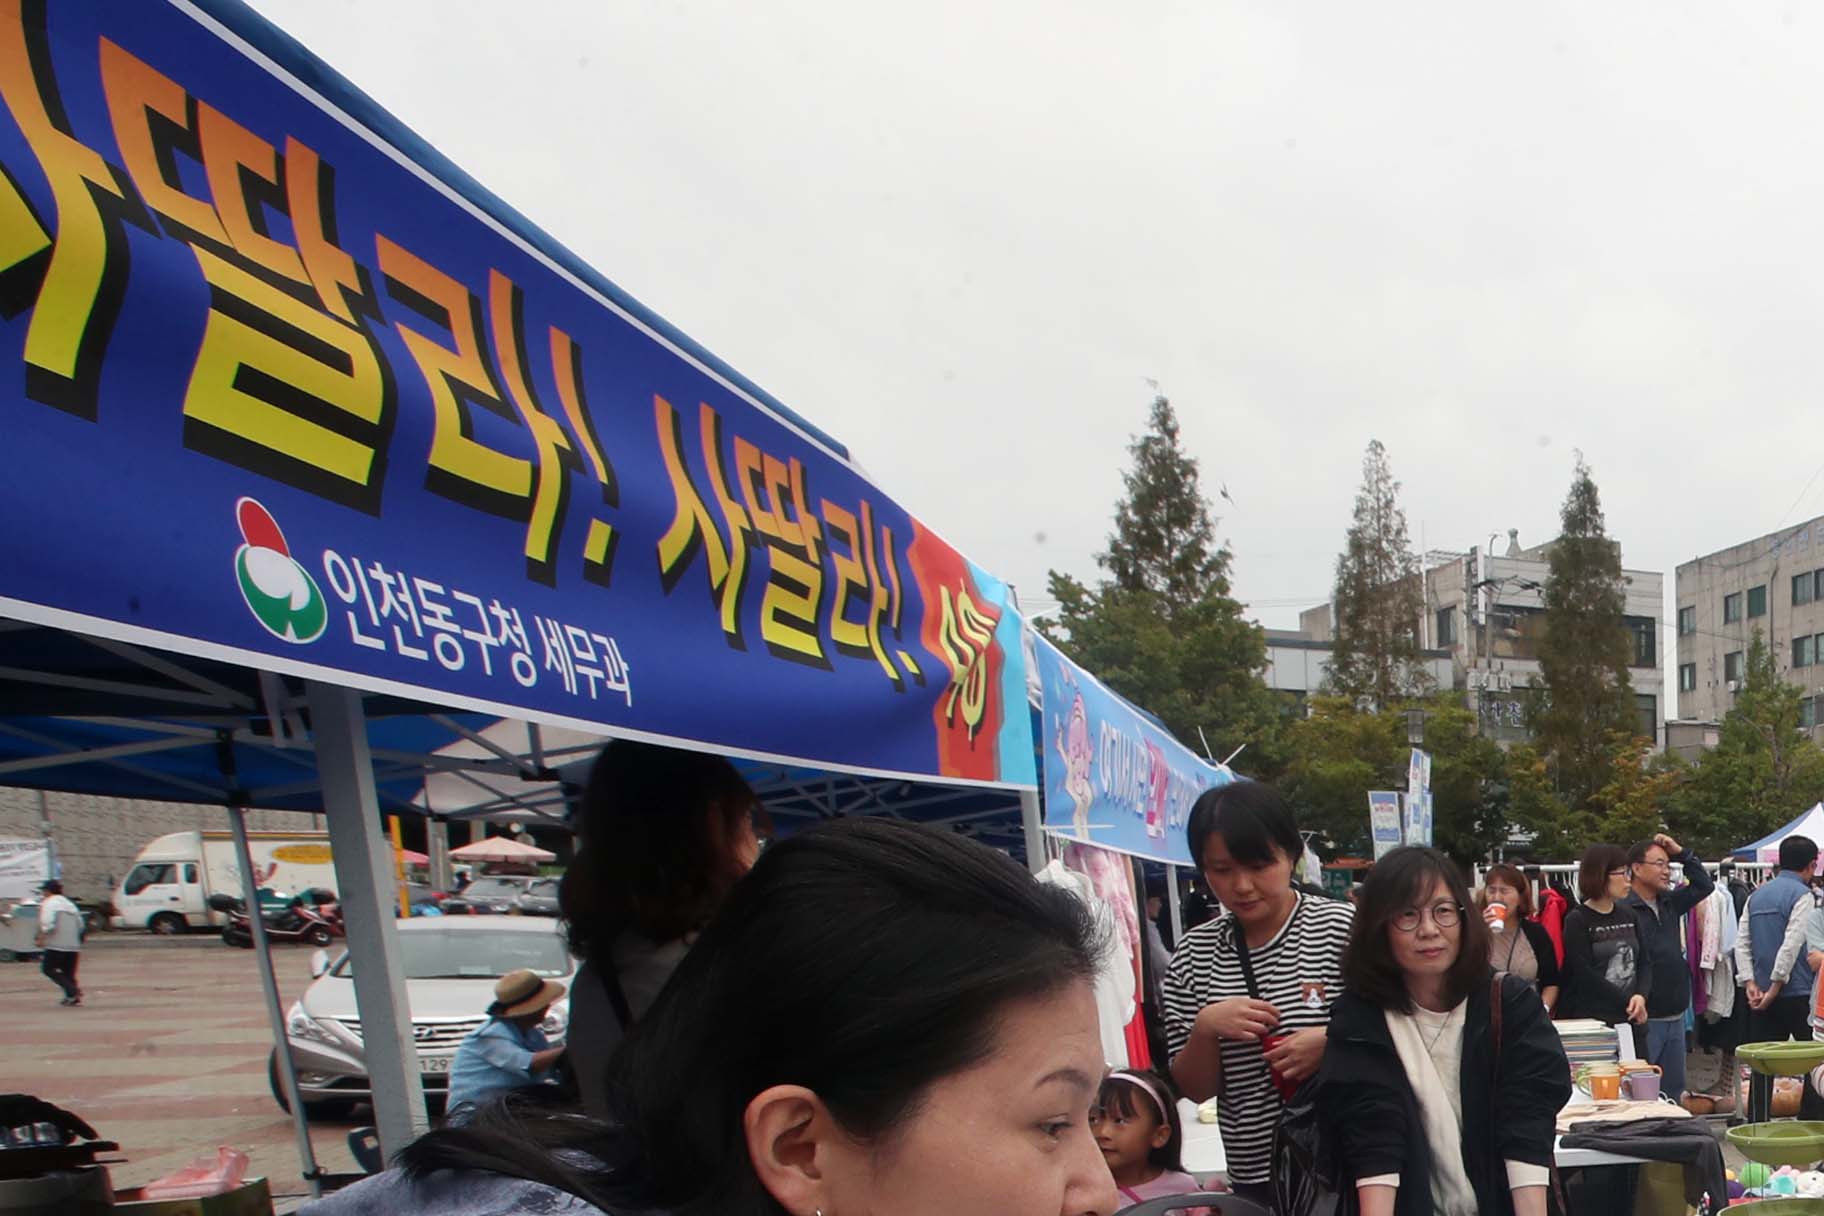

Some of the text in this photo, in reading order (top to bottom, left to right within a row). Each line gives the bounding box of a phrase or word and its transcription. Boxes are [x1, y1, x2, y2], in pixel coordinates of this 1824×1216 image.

[322, 549, 633, 708] 인천동구청 세무과
[653, 393, 919, 680] 사딸라!
